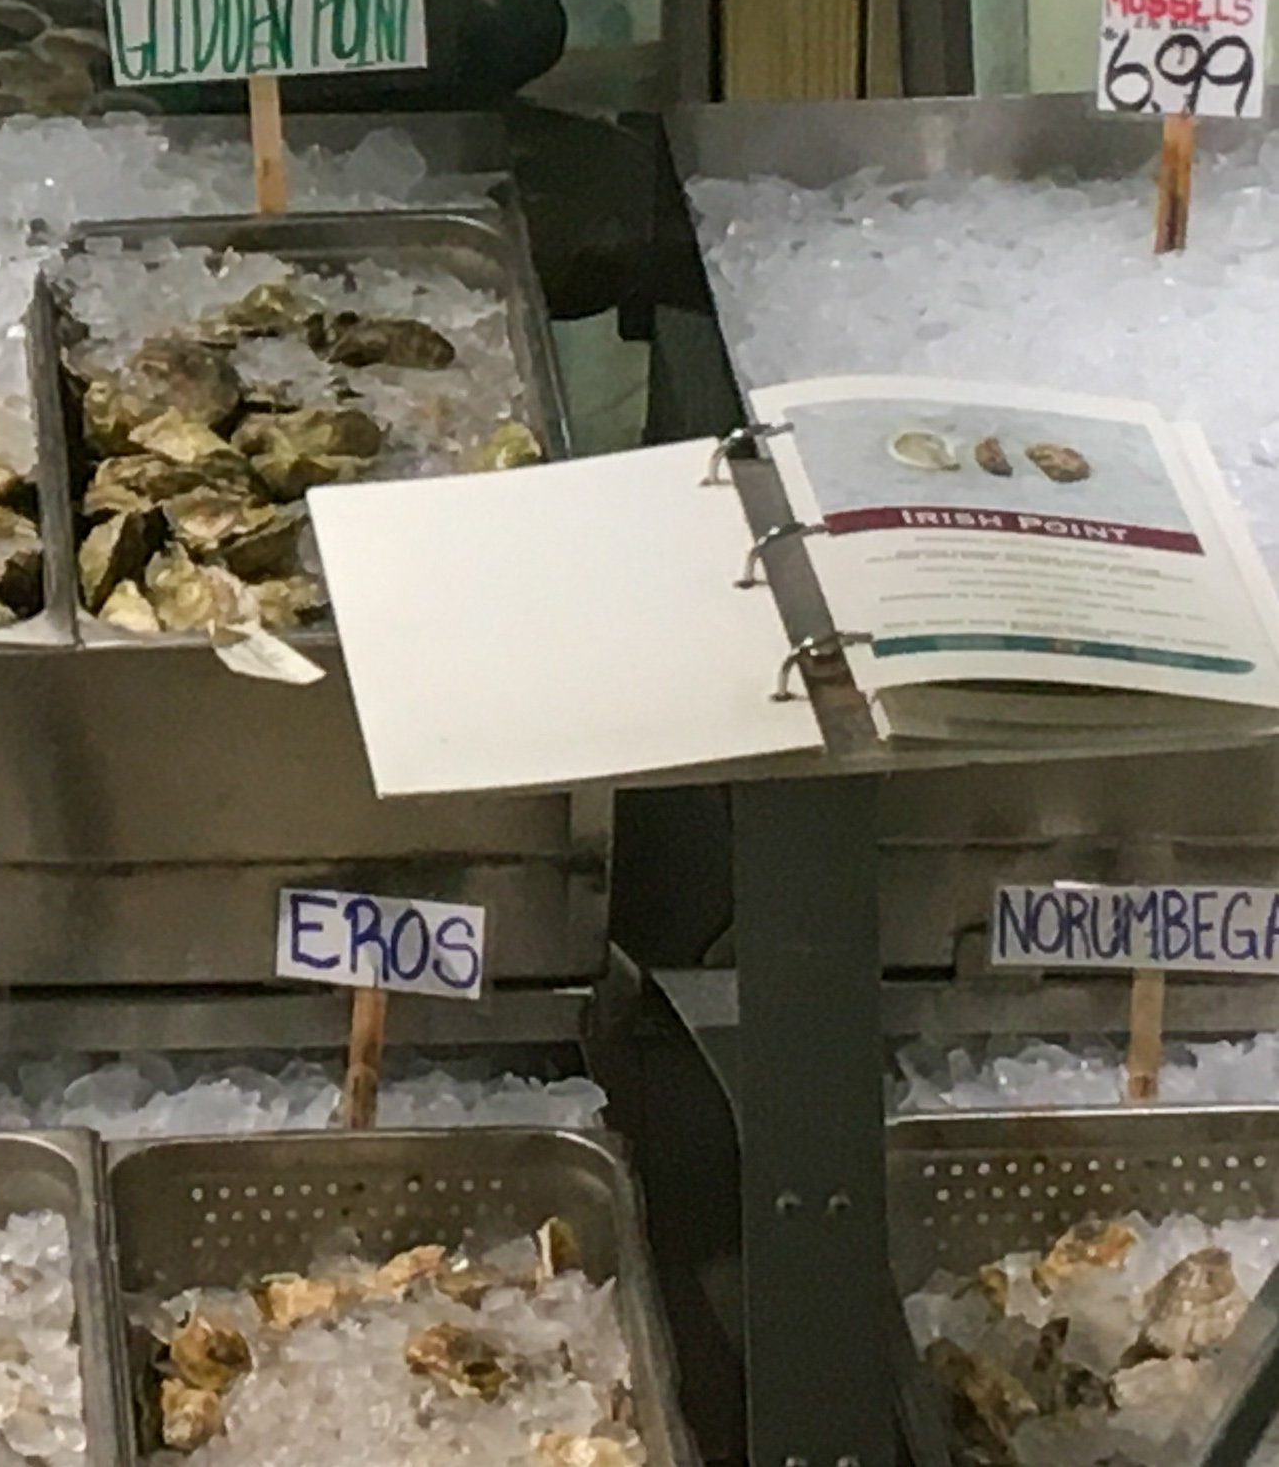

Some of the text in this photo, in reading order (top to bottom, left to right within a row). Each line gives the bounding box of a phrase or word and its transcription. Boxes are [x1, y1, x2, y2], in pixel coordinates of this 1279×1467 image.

[900, 508, 1129, 542] IRISH POINT
[288, 891, 482, 992] EROS
